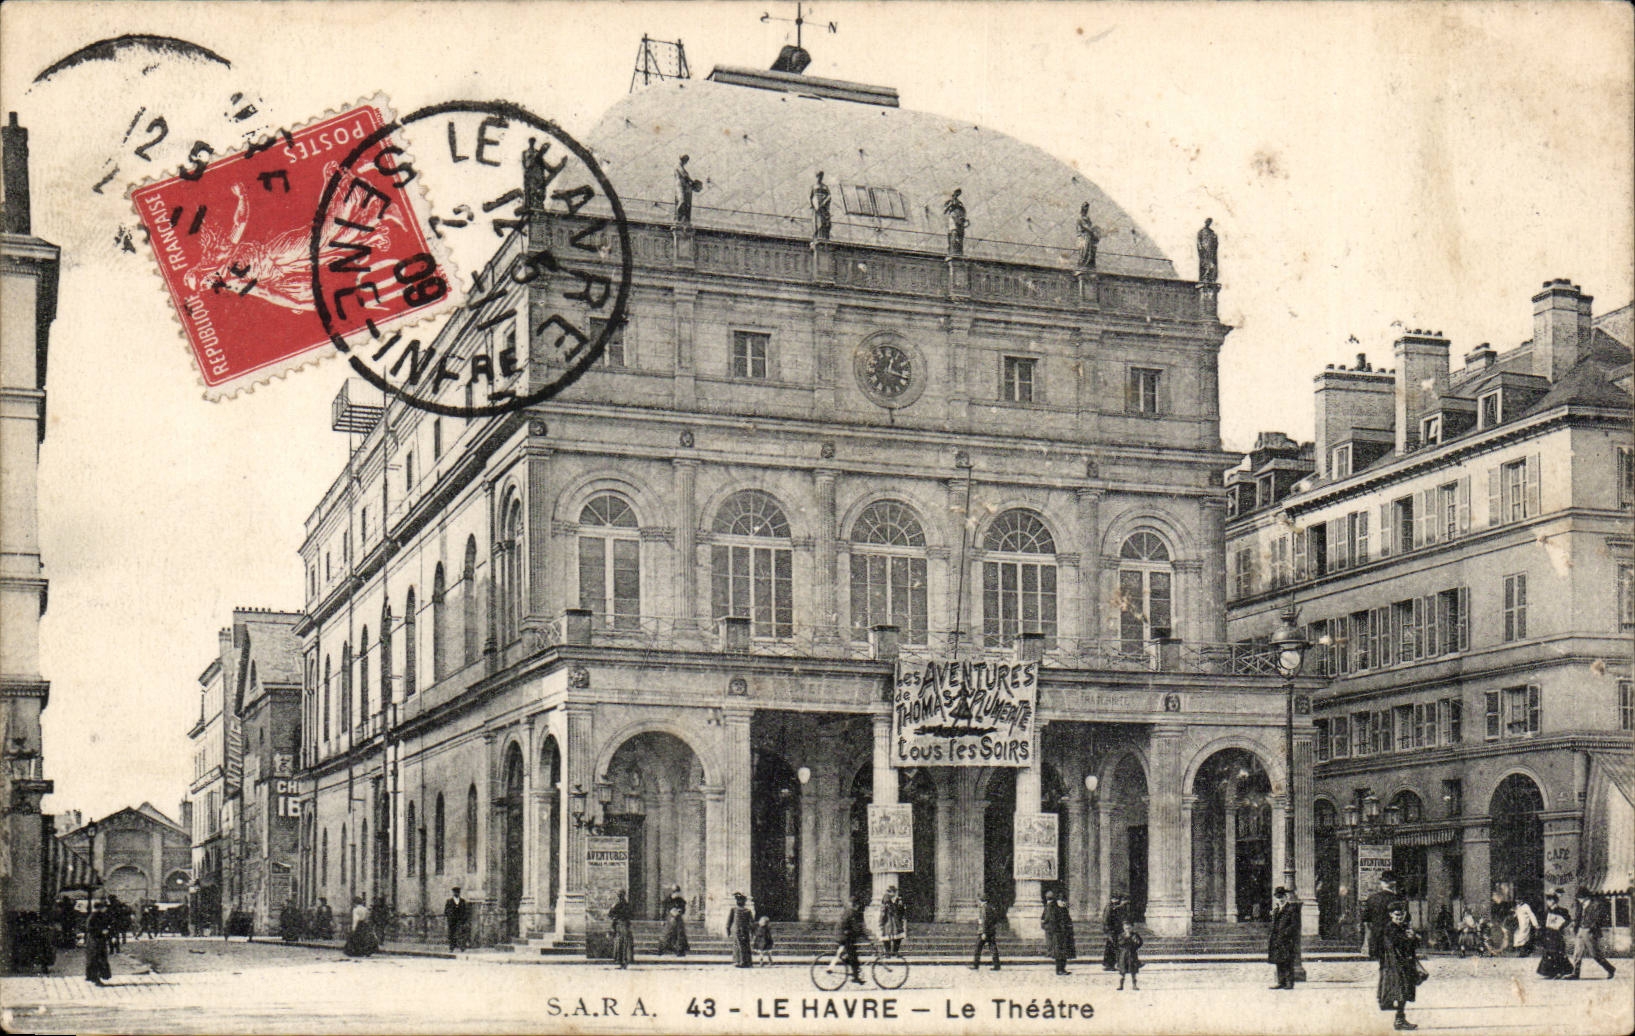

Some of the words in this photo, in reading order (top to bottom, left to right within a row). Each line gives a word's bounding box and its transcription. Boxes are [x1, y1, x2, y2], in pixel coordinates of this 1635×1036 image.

[918, 661, 1035, 699] AVENTURES
[895, 689, 911, 703] de
[896, 689, 955, 736] THOMAS
[587, 850, 628, 861] AVENTURES
